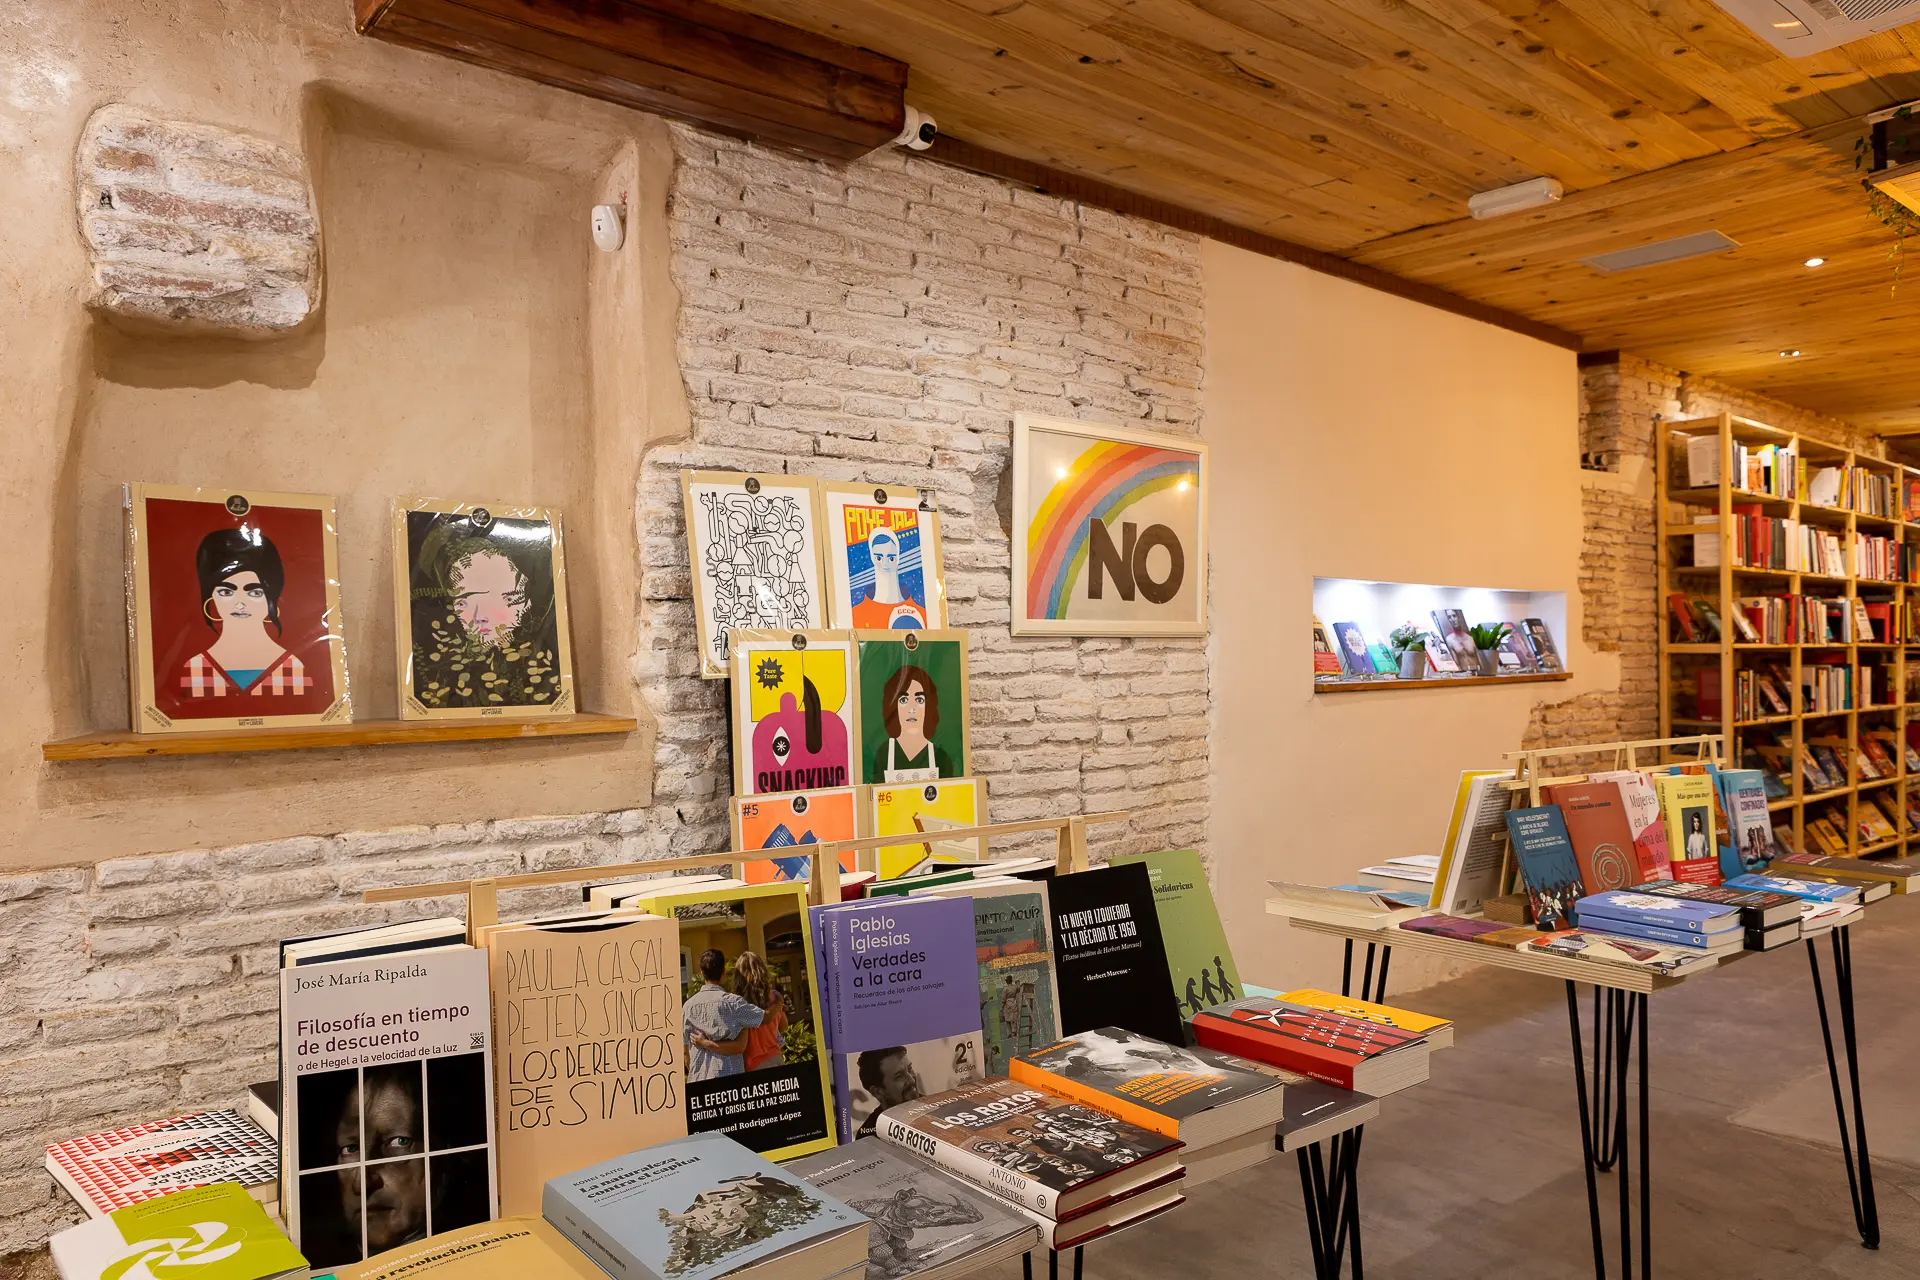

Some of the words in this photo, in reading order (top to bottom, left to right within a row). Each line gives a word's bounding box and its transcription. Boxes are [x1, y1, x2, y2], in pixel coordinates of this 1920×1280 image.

[1088, 517, 1185, 605] NO
[877, 791, 892, 803] #6
[1629, 793, 1656, 810] Mujeres
[742, 804, 759, 817] #5
[1634, 818, 1641, 828] en
[1641, 815, 1649, 826] la
[1654, 830, 1664, 843] del
[1153, 882, 1193, 895] Solidaricus
[850, 916, 895, 933] Pablo
[975, 911, 1007, 926] PINTO
[1010, 905, 1040, 921] AQUÍ?
[1059, 914, 1070, 930] LA
[1069, 909, 1094, 928] NUEVA
[1094, 903, 1131, 924] IZQUIERDA
[851, 932, 911, 954] Iglesias
[1060, 933, 1068, 949] Y
[1068, 931, 1079, 948] LA
[1078, 926, 1108, 946] DÉCADA
[1107, 924, 1118, 940] DE
[1118, 920, 1137, 938] 1960
[852, 950, 926, 971] Verdades
[1103, 945, 1120, 954] Herbert
[506, 945, 590, 995] PAULA
[597, 937, 674, 986] CASAL
[853, 976, 863, 988] a
[869, 972, 883, 986] la
[888, 968, 922, 983] cara
[1086, 972, 1106, 981] Herbert
[1107, 969, 1128, 977] Marcuse
[294, 976, 325, 994] José
[329, 970, 370, 987] María
[375, 964, 428, 984] Ripalda
[854, 990, 886, 1000] Recuerdos
[887, 987, 895, 996] de
[897, 986, 905, 994] los
[907, 984, 920, 993] años
[922, 981, 945, 990] salvajes
[297, 1012, 376, 1037] Filosofía
[381, 1013, 403, 1026] en
[408, 1005, 470, 1023] tiempo
[508, 993, 589, 1046] PETER
[599, 984, 674, 1037] SINGER
[297, 1039, 320, 1056] de
[326, 1029, 420, 1052] descuento
[1318, 1026, 1329, 1037] DEL
[297, 1064, 304, 1072] o
[305, 1060, 318, 1071] de
[320, 1055, 350, 1069] Hegel
[351, 1056, 358, 1065] a
[360, 1052, 369, 1063] la
[370, 1047, 417, 1062] velocidad
[418, 1046, 431, 1056] de
[432, 1045, 441, 1055] la
[443, 1043, 458, 1053] luz
[509, 1048, 561, 1085] LOS
[565, 1033, 676, 1079] DERECHOS
[954, 1040, 973, 1065] 2ª
[954, 1064, 977, 1074] edición
[510, 1084, 554, 1107] DE
[559, 1070, 677, 1126] SIMIOS
[690, 1096, 703, 1110] EL
[704, 1089, 739, 1107] EFECTO
[740, 1082, 770, 1099] CLASE
[771, 1076, 800, 1093] MEDIA
[718, 1107, 725, 1116] Y
[725, 1103, 746, 1115] CRISIS
[747, 1101, 756, 1111] DE
[756, 1099, 765, 1109] LA
[765, 1096, 778, 1107] PAZ
[778, 1092, 800, 1104] SOCIAL
[907, 1096, 959, 1117] ANTONIO
[958, 1079, 1011, 1102] MAESTRE
[509, 1105, 555, 1131] LOS
[739, 1116, 778, 1130] Rodríguez
[779, 1111, 802, 1123] López
[930, 1112, 979, 1131] LOS
[972, 1089, 1044, 1118] ROTOS
[887, 1121, 905, 1141] LOS
[906, 1130, 938, 1156] ROTOS
[148, 1163, 213, 1180] GUERRA
[173, 1161, 245, 1179] HISTORIA
[573, 1175, 598, 1187] KOHEI
[600, 1167, 624, 1178] SAITO
[579, 1183, 599, 1194] La
[600, 1157, 677, 1188] naturaleza
[587, 1179, 637, 1199] contra
[637, 1171, 651, 1181] el
[650, 1156, 701, 1176] capital
[853, 1159, 884, 1174] negro
[988, 1167, 1026, 1191] ANTONIO
[987, 1179, 1026, 1205] MAESTRE
[360, 1258, 408, 1278] MASSIMO
[409, 1240, 461, 1260] MODONESI
[389, 1243, 478, 1277] revolución
[480, 1229, 531, 1247] pasiva
